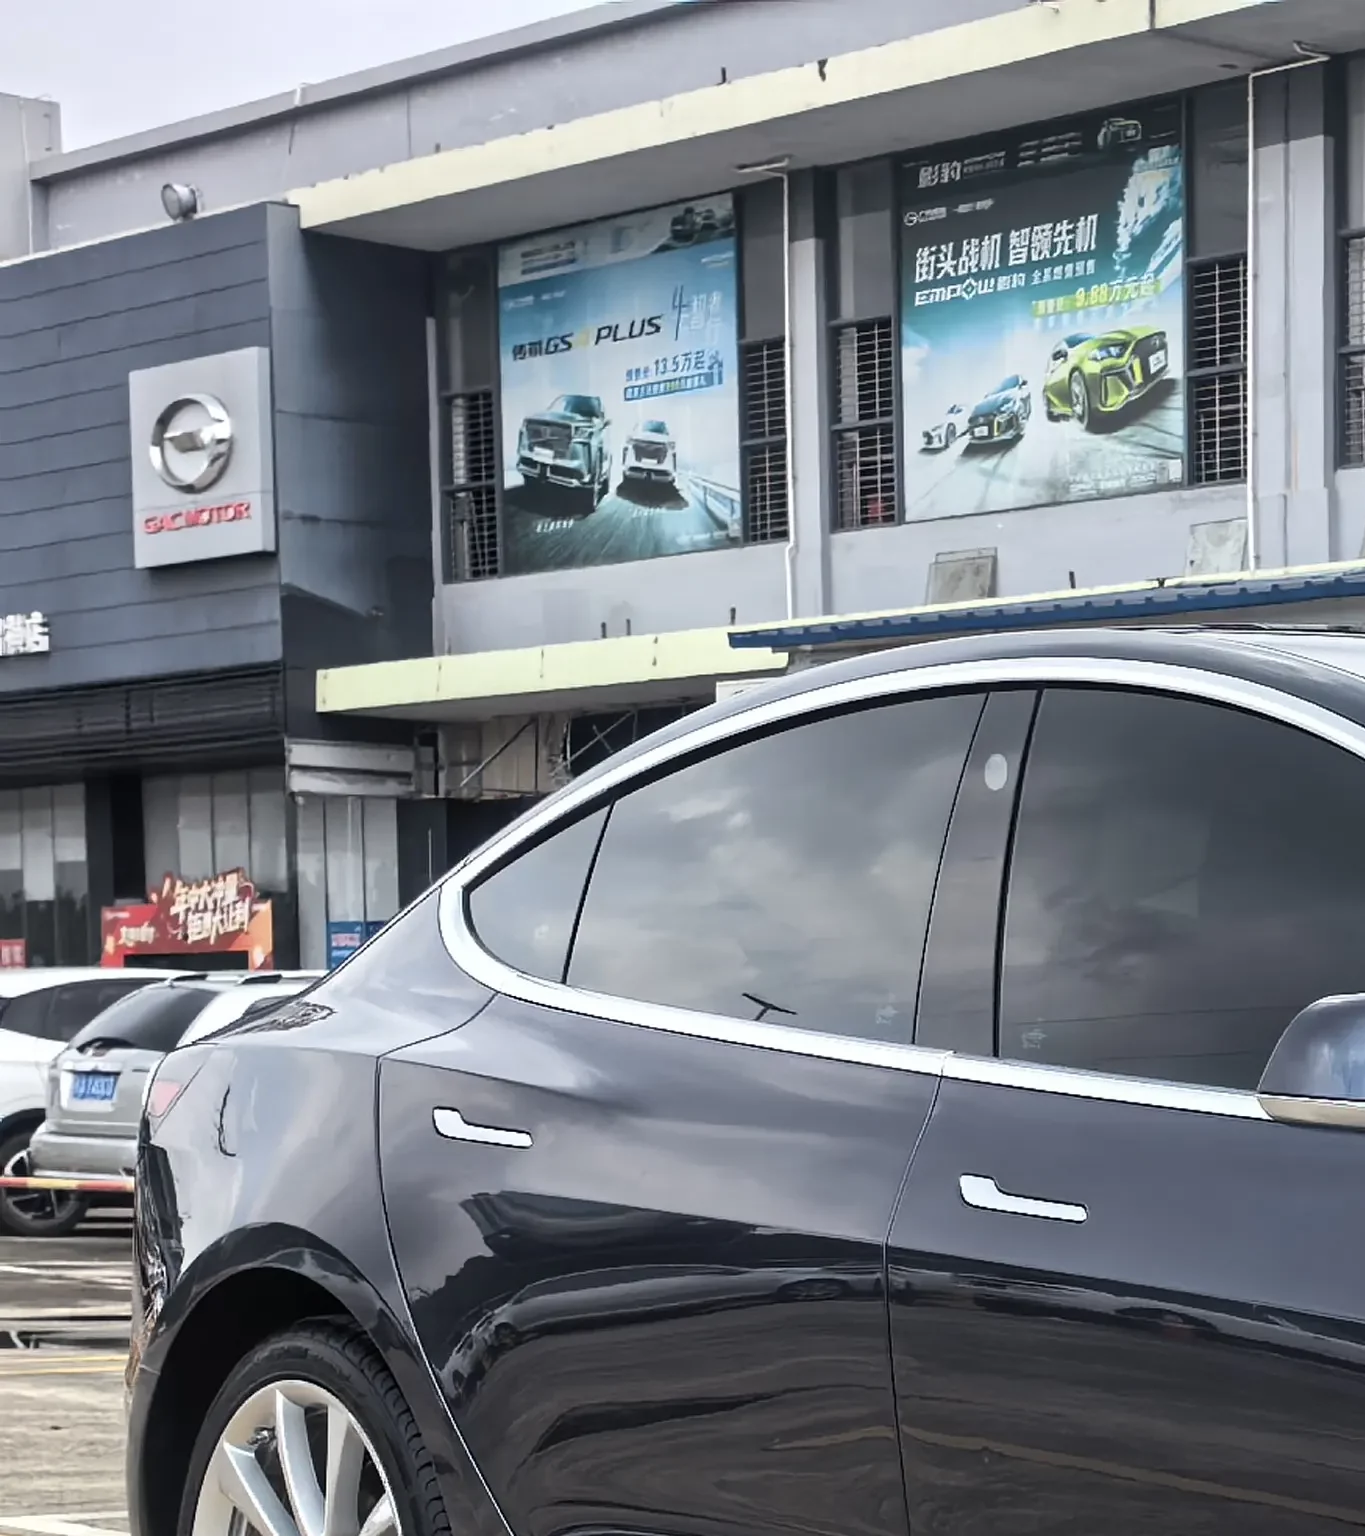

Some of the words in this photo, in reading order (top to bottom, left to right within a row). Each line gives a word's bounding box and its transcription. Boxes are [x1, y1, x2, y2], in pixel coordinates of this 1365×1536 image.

[914, 232, 1003, 283] 街头战机
[1008, 213, 1099, 267] 智领先机
[594, 313, 665, 346] PLUS
